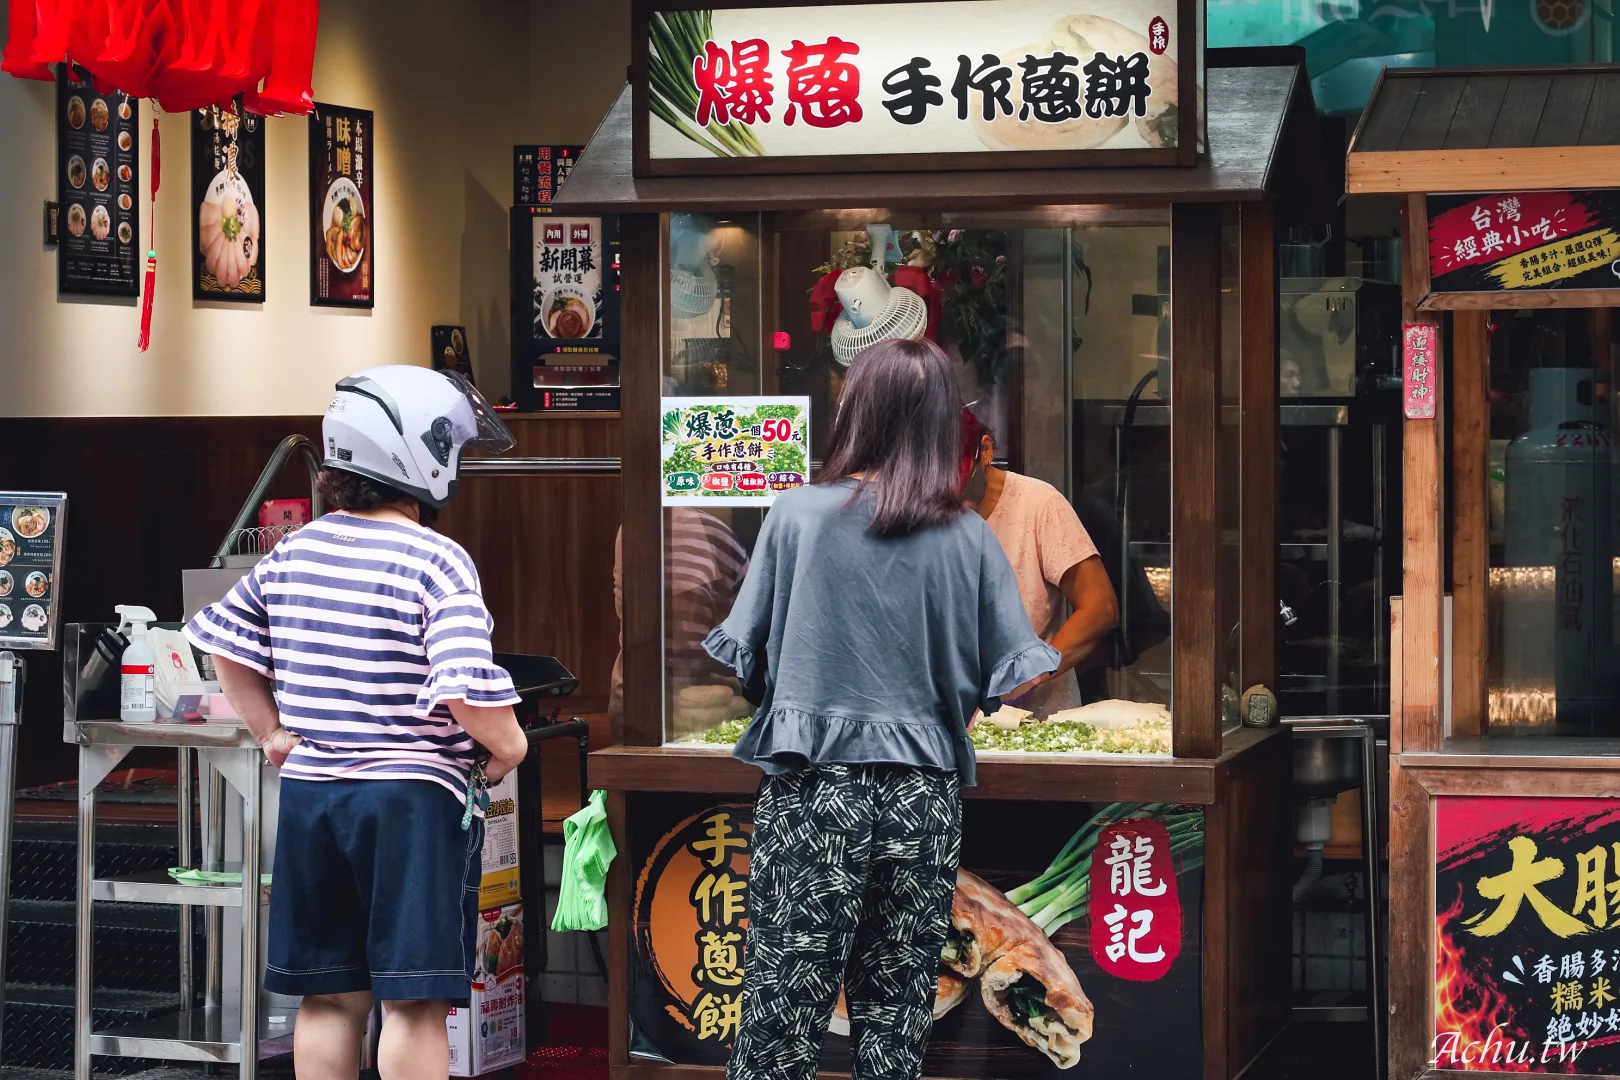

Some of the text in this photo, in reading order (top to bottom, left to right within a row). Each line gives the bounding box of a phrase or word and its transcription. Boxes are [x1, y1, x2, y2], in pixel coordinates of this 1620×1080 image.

[1152, 22, 1166, 50] 手作
[695, 37, 1151, 128] 爆蔥 手作蔥餅
[336, 117, 351, 176] 味噌
[538, 147, 551, 203] 用餐流程
[1471, 196, 1521, 231] 台灣
[1453, 217, 1558, 262] 經典小吃
[538, 246, 597, 274] 新開幕
[552, 273, 584, 284] 試營運
[1411, 336, 1430, 400] 迎接財神
[685, 410, 739, 440] 爆蔥
[701, 441, 763, 461] 手作蔥餅
[675, 476, 696, 487] 原味
[779, 473, 797, 482] 綜合
[1104, 835, 1168, 963] 龍記
[691, 812, 749, 1042] 手作蔥餅
